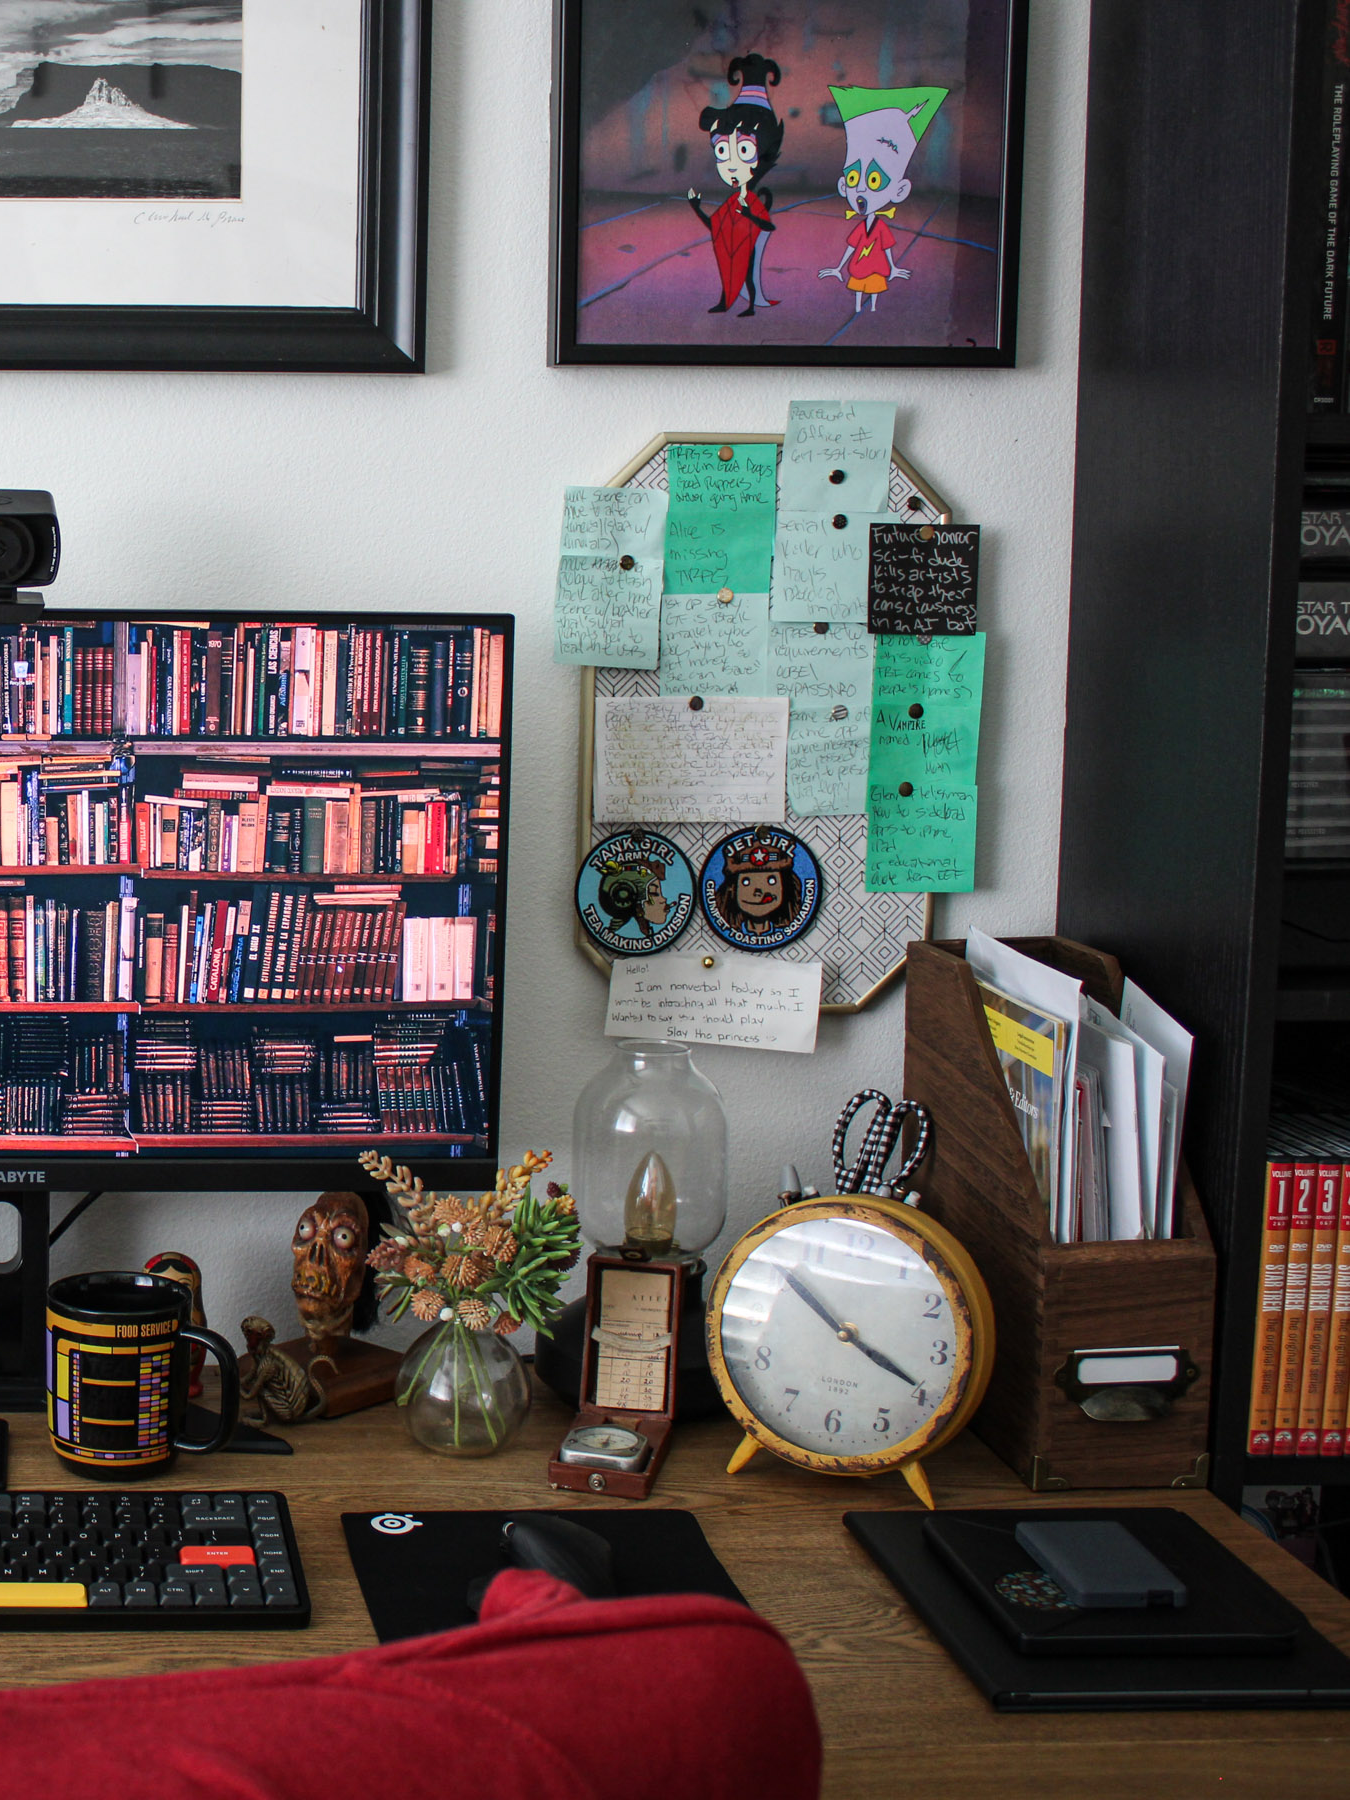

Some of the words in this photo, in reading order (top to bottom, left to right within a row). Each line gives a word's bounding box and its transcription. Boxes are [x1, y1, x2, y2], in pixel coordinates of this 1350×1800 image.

[1334, 84, 1343, 104] THE
[1330, 107, 1342, 177] ROLEPLAYING
[1329, 179, 1339, 209] GAME
[1328, 211, 1337, 225] OF
[1327, 228, 1336, 248] THE
[1325, 250, 1335, 278] DARK
[1323, 280, 1333, 320] FUTURE
[796, 425, 842, 444] Office
[669, 522, 698, 537] Alice
[1301, 511, 1342, 525] STAR
[928, 548, 969, 567] dude
[908, 567, 972, 584] artists
[871, 580, 886, 593] to
[889, 583, 924, 603] trap
[928, 583, 972, 602] their
[873, 598, 977, 619] consciousness
[1296, 601, 1336, 615] STAR
[872, 615, 890, 629] in
[894, 620, 912, 633] an
[914, 618, 939, 633] AI
[946, 615, 977, 634] bot
[208, 640, 222, 648] 1970
[268, 629, 279, 660] CIENCIAS
[268, 661, 278, 674] LAS
[875, 709, 887, 728] A
[879, 734, 911, 746] named
[590, 838, 634, 869] TANK
[640, 838, 675, 865] GIRL
[617, 851, 650, 862] ARMY
[725, 834, 755, 858] JET
[760, 834, 798, 858] GIRL
[267, 892, 280, 932] EXTINGUIDAS
[294, 894, 307, 931] OCCIDENTAL
[583, 903, 602, 935] TEA
[600, 928, 652, 951] MAKING
[651, 893, 692, 947] DIVISION
[705, 879, 730, 933] CRUMPET
[729, 929, 785, 947] TOASTING
[783, 879, 816, 938] SQUADRON
[251, 924, 261, 934] XX
[250, 936, 259, 952] SIGLO
[278, 942, 287, 951] DE
[210, 947, 221, 991] CATALONIA
[261, 935, 274, 983] CIVILIZACIONES
[626, 963, 649, 975] Hello!
[634, 981, 644, 993] I
[731, 982, 764, 997] today
[788, 988, 800, 997] I
[706, 998, 717, 1006] all
[725, 997, 748, 1008] that
[793, 1001, 804, 1011] I
[647, 1013, 657, 1022] to
[659, 1015, 672, 1023] say
[740, 1014, 764, 1026] play
[667, 1026, 688, 1038] Slay
[718, 1033, 760, 1043] princess
[1014, 1089, 1039, 1119] Editors
[1272, 1170, 1292, 1178] VOLUME
[1295, 1169, 1315, 1177] VOLUME
[1319, 1169, 1340, 1177] VOLUME
[1278, 1180, 1286, 1214] 1
[1298, 1178, 1310, 1212] 2
[1322, 1179, 1334, 1213] 3
[802, 1242, 827, 1265] 11
[845, 1233, 875, 1260] 12
[1269, 1244, 1285, 1252] DVD
[1292, 1243, 1308, 1251] DVD
[1316, 1243, 1332, 1251] DVD
[897, 1255, 911, 1280] 1
[1264, 1264, 1285, 1287] STAR
[1286, 1263, 1308, 1286] STAR
[1311, 1263, 1332, 1286] STAR
[923, 1293, 942, 1320] 2
[1262, 1288, 1283, 1312] TREK
[1285, 1287, 1306, 1310] TREK
[1309, 1287, 1330, 1311] TREK
[116, 1325, 139, 1338] FOOD
[140, 1320, 172, 1337] SERVICE
[1266, 1319, 1278, 1332] the
[1289, 1318, 1301, 1330] the
[1313, 1318, 1324, 1331] the
[754, 1345, 772, 1371] 8
[930, 1340, 948, 1366] 3
[1262, 1335, 1275, 1366] original
[1285, 1333, 1298, 1365] original
[1309, 1334, 1322, 1365] original
[821, 1375, 859, 1388] LONDON
[828, 1385, 850, 1396] 1892
[783, 1387, 800, 1413] 7
[911, 1380, 928, 1407] 4
[824, 1408, 842, 1434] 6
[873, 1407, 891, 1433] 5
